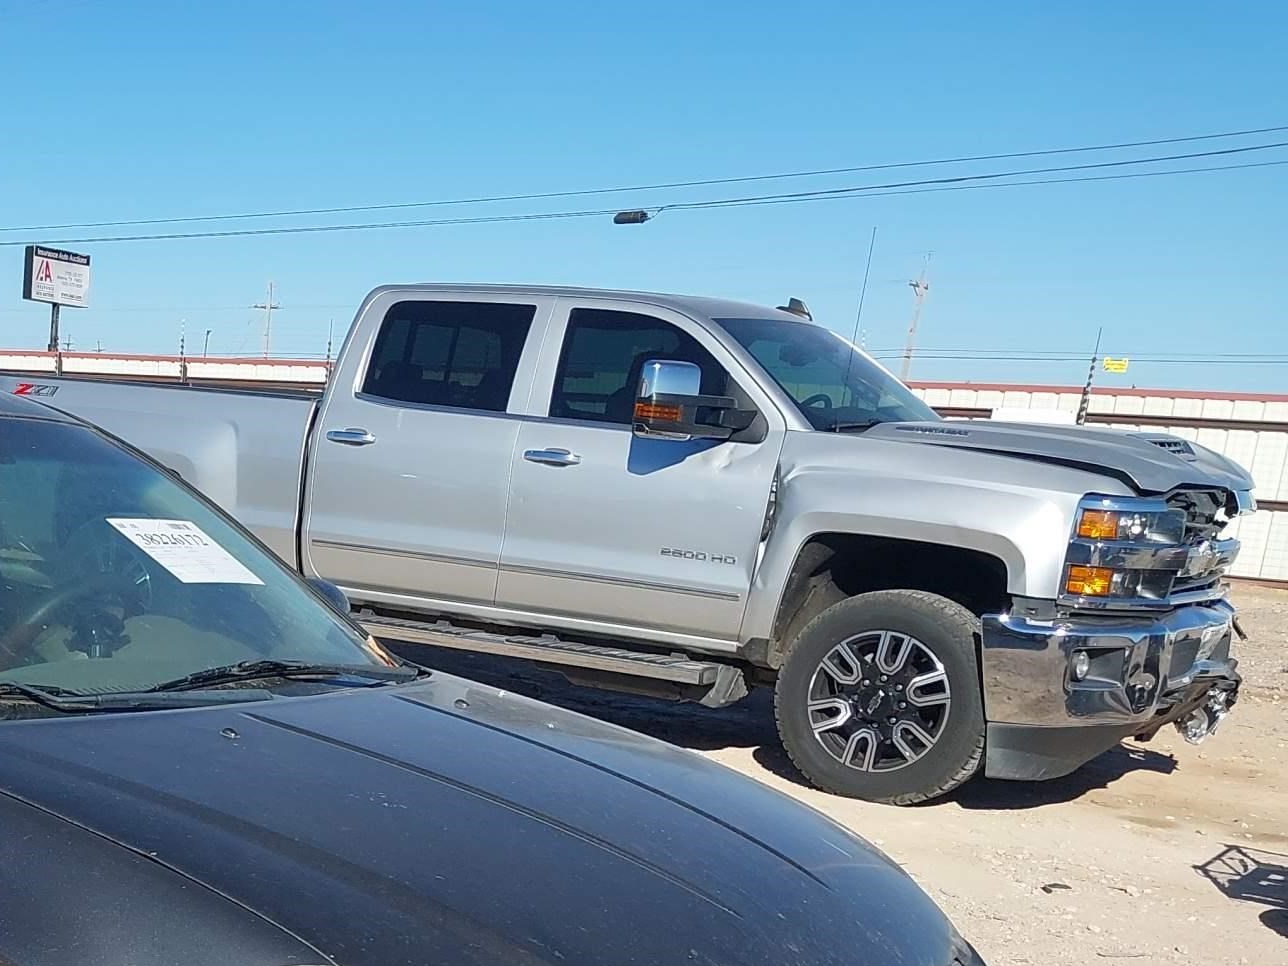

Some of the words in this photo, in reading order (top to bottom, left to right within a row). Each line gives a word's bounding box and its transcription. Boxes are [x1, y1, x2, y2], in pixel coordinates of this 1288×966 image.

[12, 383, 60, 397] Z71
[135, 533, 209, 546] 38226172
[711, 554, 737, 565] HD
